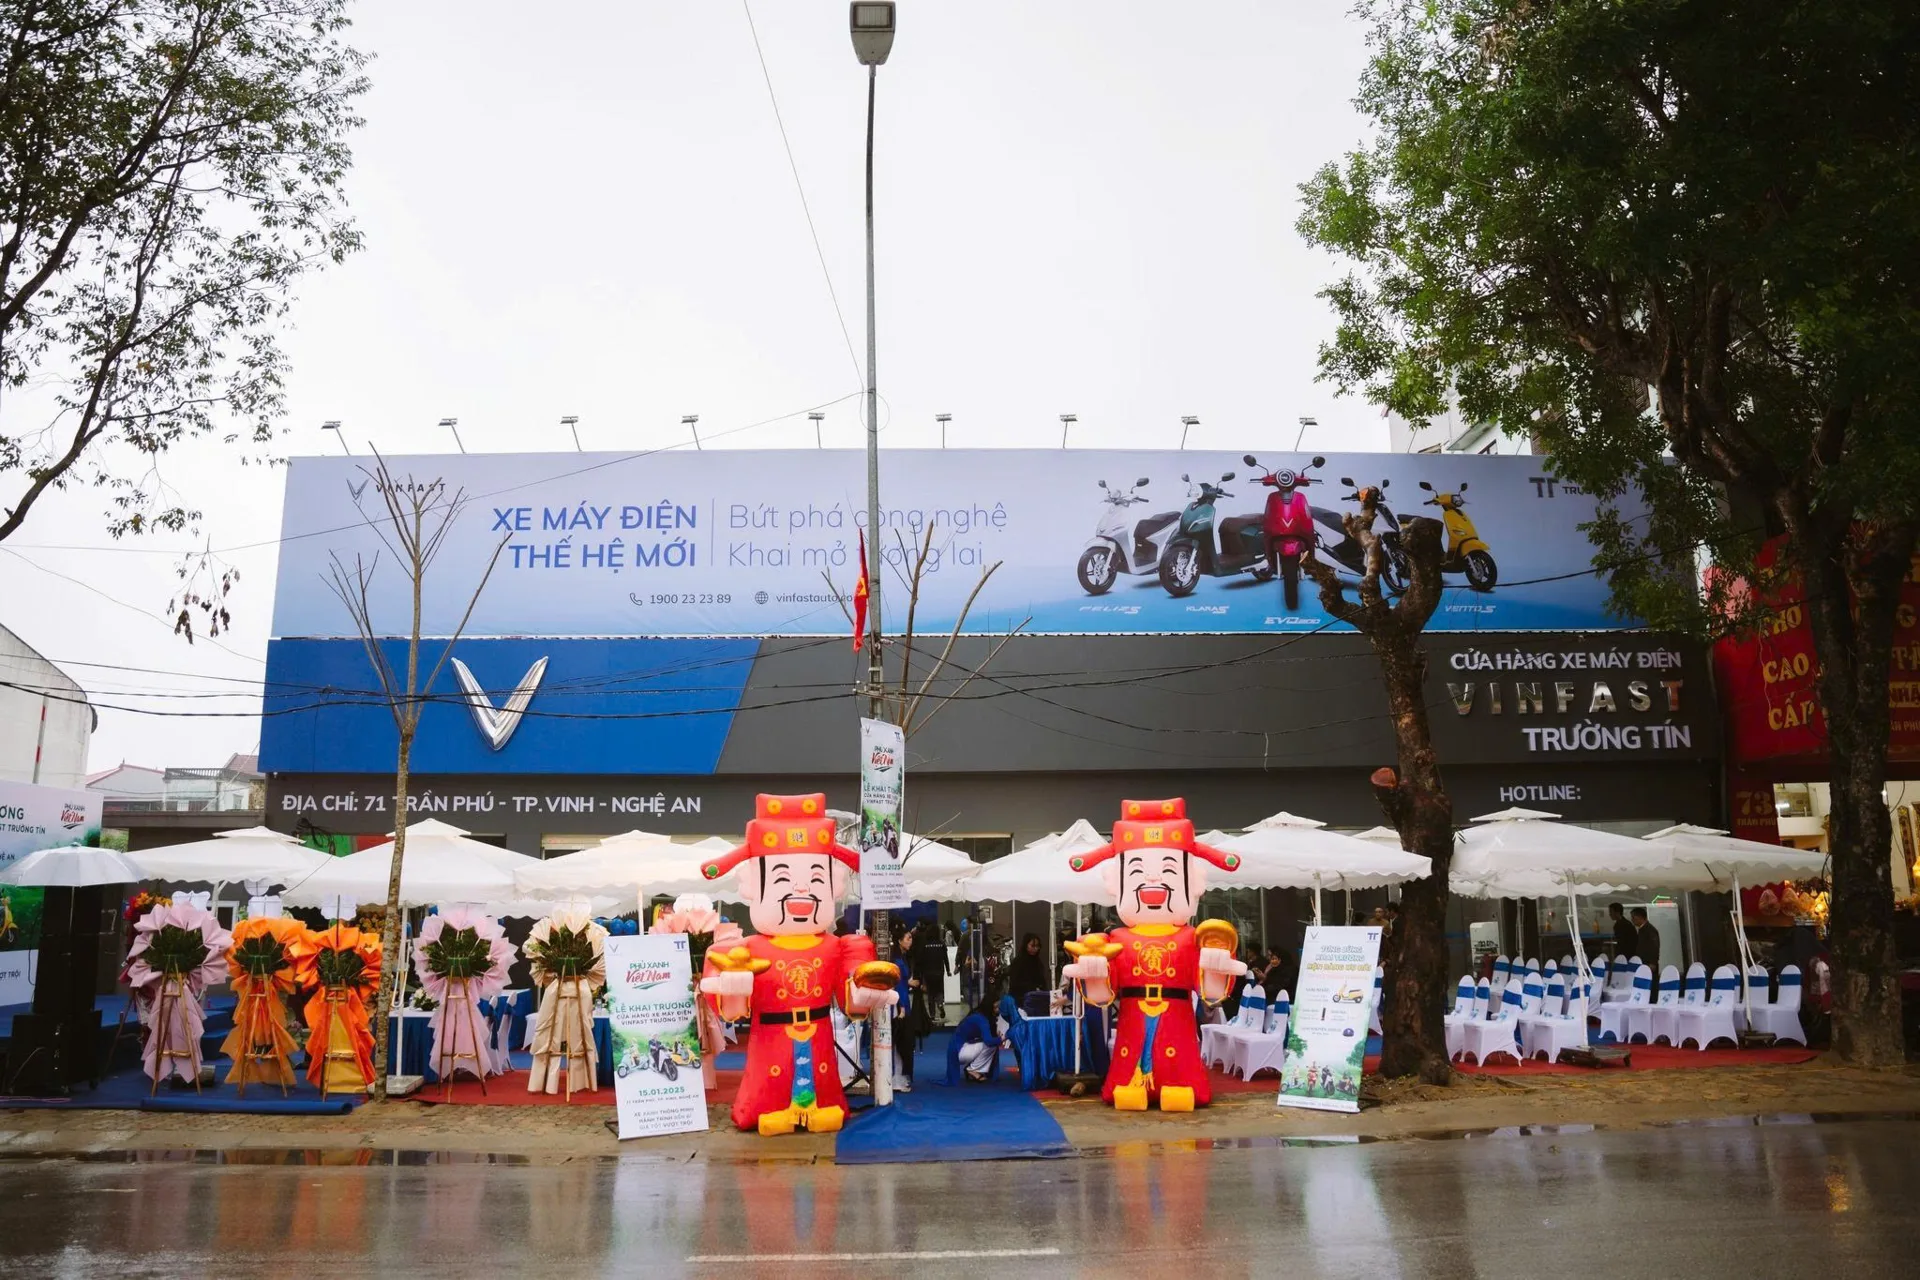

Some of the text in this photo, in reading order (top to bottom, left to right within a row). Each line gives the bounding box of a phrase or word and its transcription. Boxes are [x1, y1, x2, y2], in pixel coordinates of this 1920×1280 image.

[491, 499, 697, 535] XE MÁY ĐIỆN
[730, 503, 779, 529] Bứt
[789, 502, 843, 534] phá
[935, 502, 1008, 534] nghệ
[508, 535, 696, 573] THẾ HỆ MỚI
[729, 542, 791, 567] Khai
[803, 540, 847, 567] mở
[952, 542, 982, 566] lai
[650, 594, 731, 604] 1900 23 23 89
[1450, 647, 1682, 672] CỬA HÀNG XE MÁY ĐIỆN
[1763, 652, 1809, 685] CAO
[1447, 679, 1684, 715] VINFAST
[1522, 719, 1692, 751] TRƯỜNG TÍN
[281, 795, 317, 815] ĐỊA
[321, 794, 358, 812] CHỈ:
[365, 796, 386, 811] 71
[453, 790, 495, 812] PHÚ
[611, 792, 665, 817] NGHỆ
[670, 797, 701, 813] AN
[1500, 785, 1581, 802] HOTLINE:
[1736, 790, 1773, 816] 73
[626, 969, 671, 985] Việt Nam
[629, 960, 669, 969] PHỦ XANH
[629, 1004, 651, 1012] KHAI
[652, 1001, 691, 1010] TRƯƠNG
[639, 1086, 685, 1096] 15.01.2025
